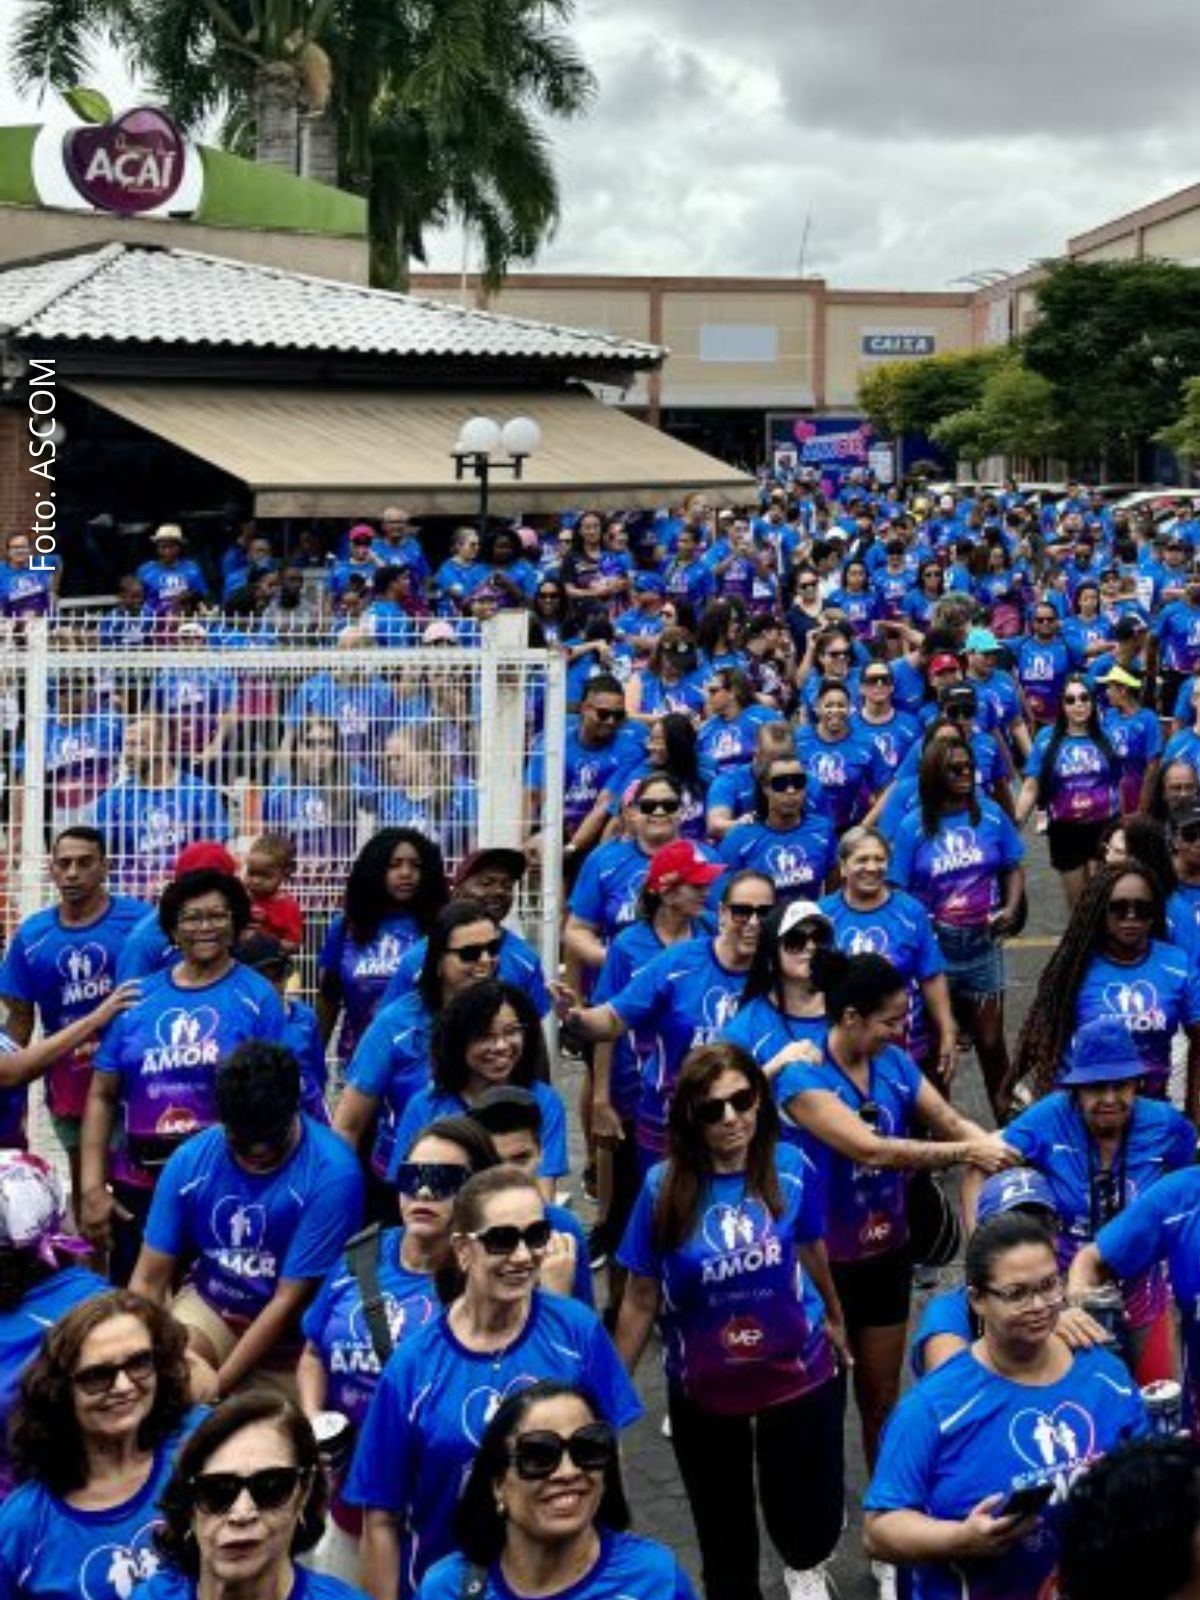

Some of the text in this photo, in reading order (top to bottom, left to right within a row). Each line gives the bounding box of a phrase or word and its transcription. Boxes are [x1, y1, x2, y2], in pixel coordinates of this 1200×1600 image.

[84, 146, 177, 189] AÇAÍ
[870, 337, 929, 352] CAIXA
[62, 979, 112, 1005] MOR
[140, 1042, 219, 1076] AMOR
[702, 1243, 782, 1284] AMOR
